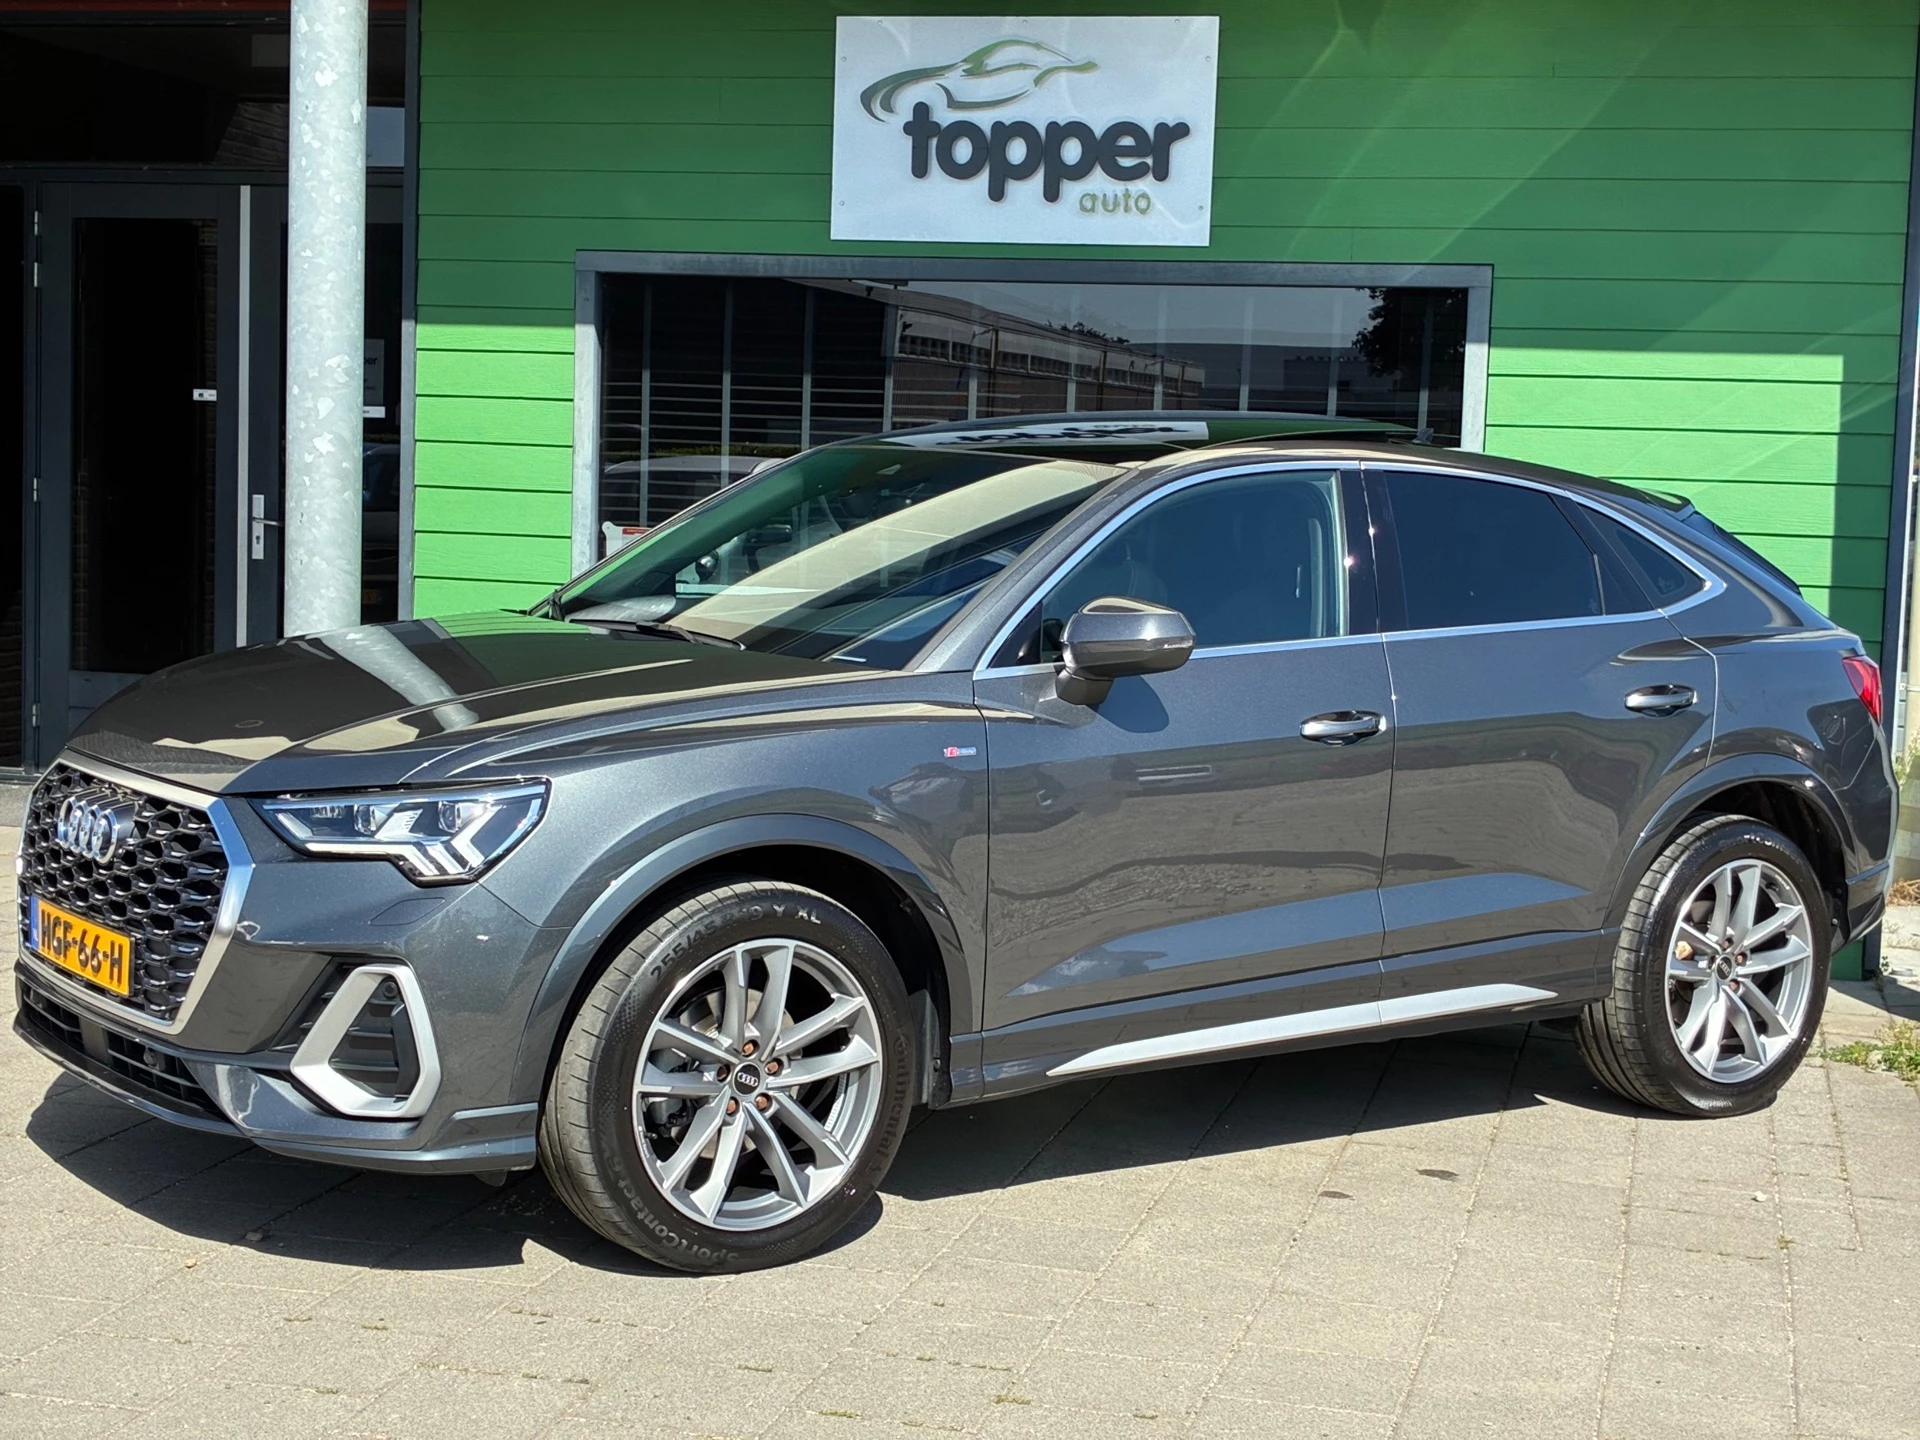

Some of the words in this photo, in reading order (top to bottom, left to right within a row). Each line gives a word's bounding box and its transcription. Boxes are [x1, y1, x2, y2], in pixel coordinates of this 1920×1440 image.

[903, 101, 1190, 202] topper
[1079, 188, 1151, 215] auto
[41, 909, 124, 987] HGF-66-H
[651, 920, 718, 984] 255/45
[739, 904, 764, 921] 19
[772, 904, 787, 917] Y
[794, 905, 822, 925] XL
